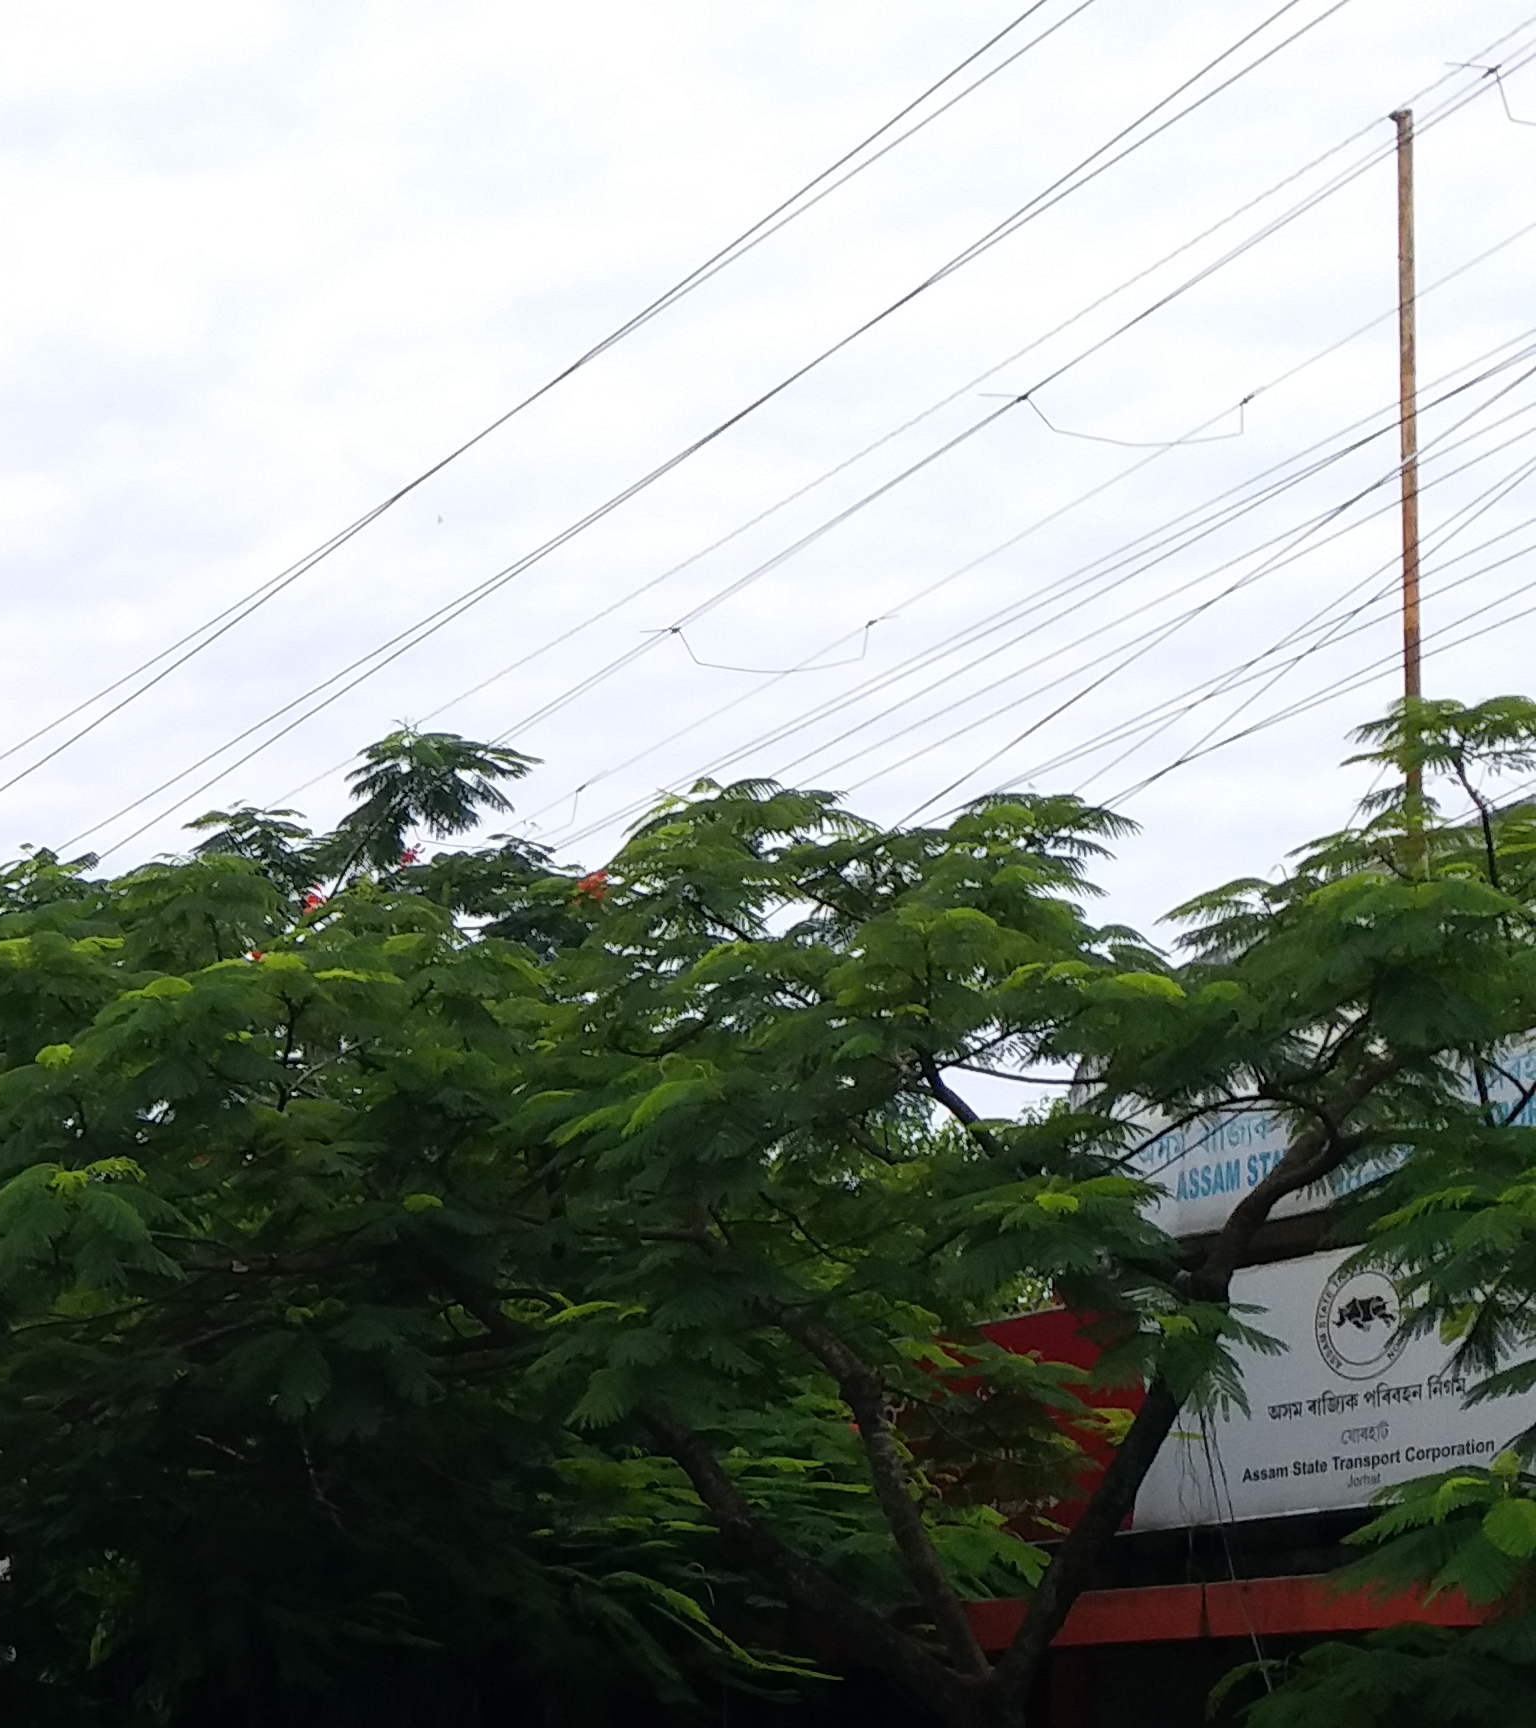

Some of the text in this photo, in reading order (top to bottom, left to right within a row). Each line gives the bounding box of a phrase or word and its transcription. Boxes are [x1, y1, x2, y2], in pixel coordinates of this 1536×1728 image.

[1177, 1157, 1241, 1200] ASSAM
[1247, 1147, 1289, 1187] STA
[1268, 1401, 1303, 1420] অসম
[1363, 1382, 1423, 1410] পৰিবহন
[1242, 1438, 1495, 1483] Assam State Transport Corporation
